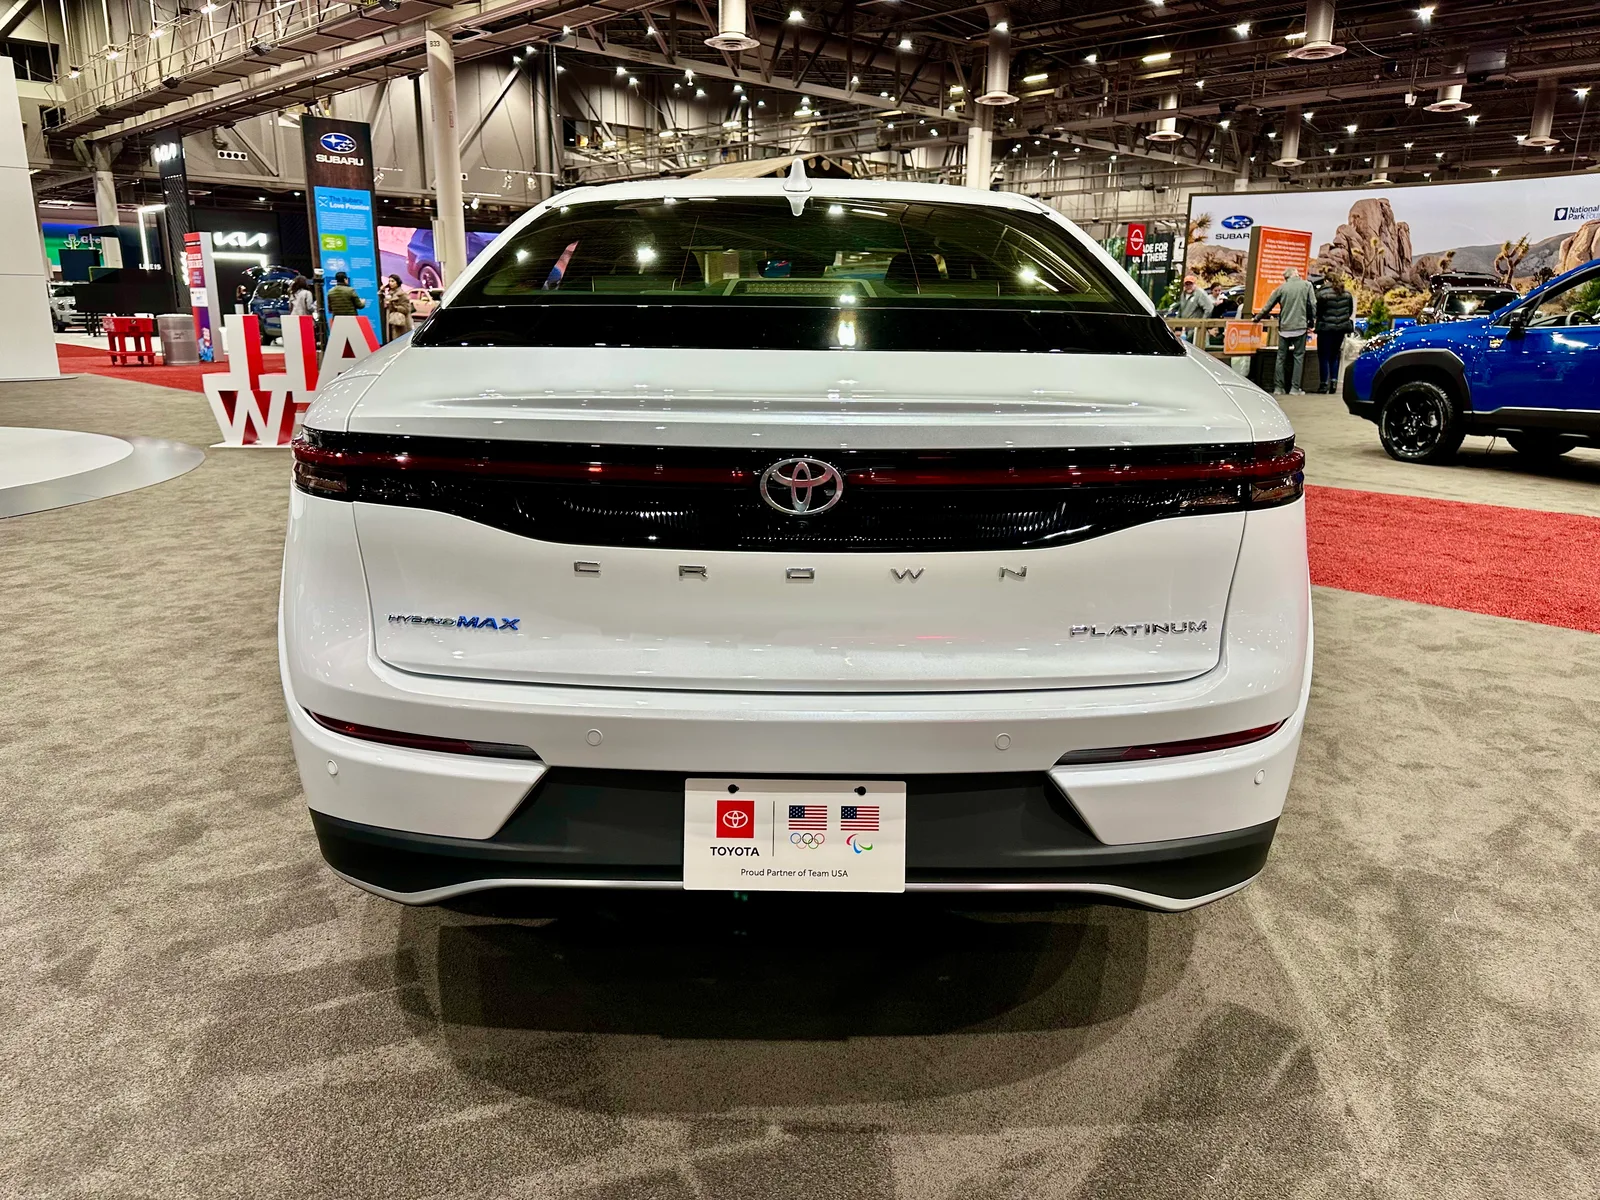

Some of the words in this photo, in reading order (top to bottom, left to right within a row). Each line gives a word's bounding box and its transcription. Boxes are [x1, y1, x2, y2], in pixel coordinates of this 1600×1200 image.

[315, 154, 364, 166] SUBARU
[345, 203, 370, 211] Promise
[1570, 205, 1600, 213] National
[213, 231, 267, 247] KIA
[1154, 242, 1168, 252] FOR
[1146, 252, 1167, 262] THERE
[573, 560, 1027, 580] CROWN
[1070, 620, 1208, 637] PLATINUM
[710, 846, 760, 857] TOYOTA
[740, 868, 765, 877] Proud
[766, 869, 797, 878] Partner
[799, 869, 807, 878] of
[808, 869, 830, 878] Team
[831, 870, 849, 878] USA
